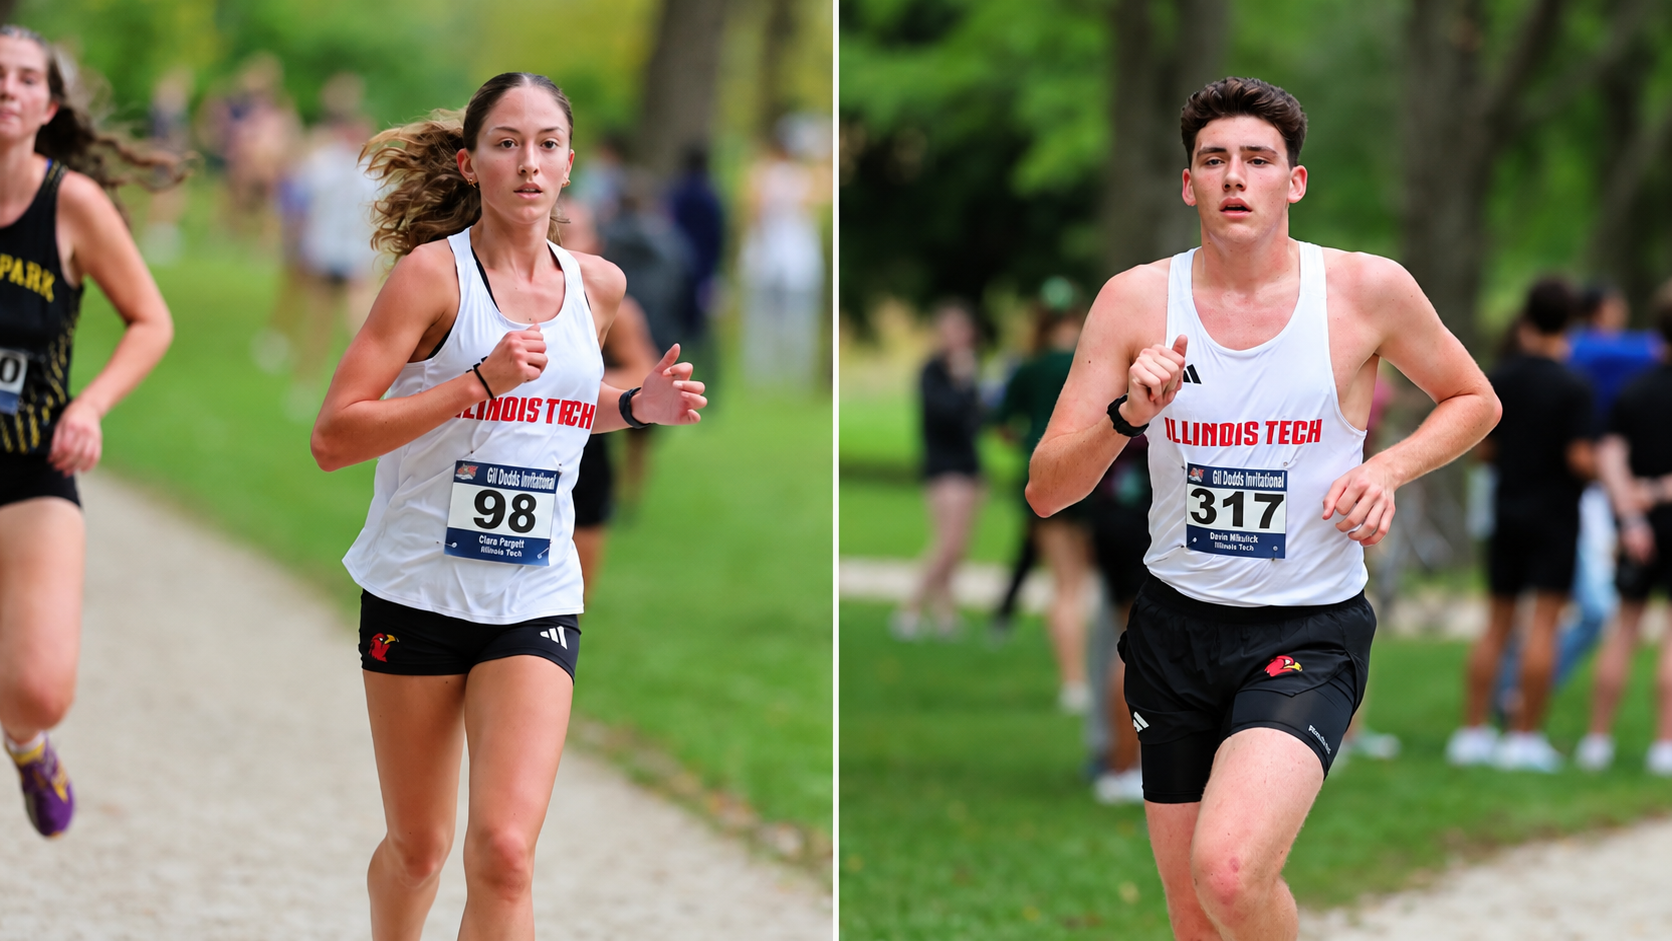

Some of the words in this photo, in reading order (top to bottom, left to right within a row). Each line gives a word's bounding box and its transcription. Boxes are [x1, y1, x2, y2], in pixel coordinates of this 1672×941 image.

[0, 253, 55, 303] PARK
[1164, 417, 1259, 447] ILLINOIS
[1265, 419, 1323, 445] TECH
[487, 467, 498, 484] Gil
[498, 470, 520, 487] Dodds
[1212, 470, 1222, 485] Gil
[1223, 470, 1244, 487] Dodds
[1245, 472, 1285, 488] Invitational
[473, 489, 537, 533] 98
[1190, 488, 1285, 529] 317
[505, 549, 522, 558] Tech
[1238, 543, 1255, 552] Tech
